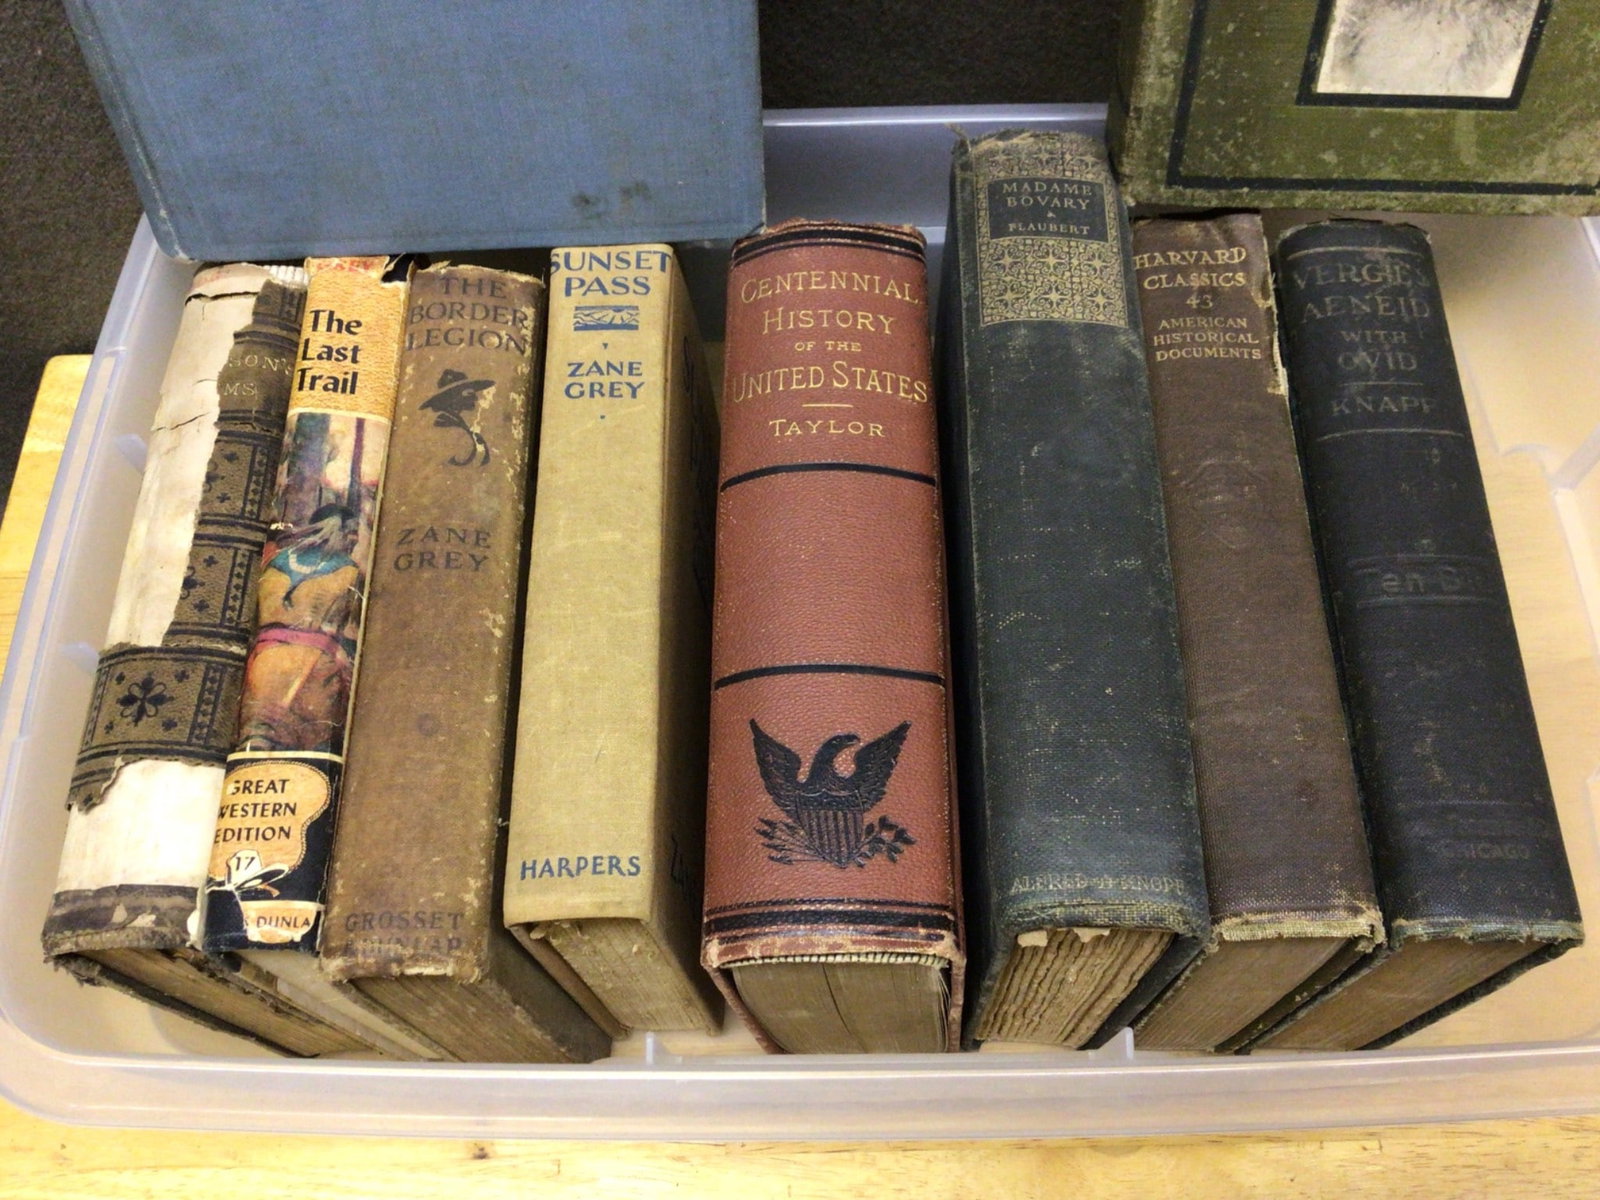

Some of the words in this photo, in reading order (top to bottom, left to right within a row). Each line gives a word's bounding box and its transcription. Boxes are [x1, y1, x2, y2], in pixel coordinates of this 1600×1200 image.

[1002, 181, 1092, 195] MADAME
[1006, 196, 1090, 210] BOVARY
[1008, 222, 1091, 235] FLAUBERT
[550, 250, 672, 276] SUNSET
[1133, 246, 1247, 270] HARVARD
[442, 276, 507, 299] THE
[564, 276, 651, 297] PASS
[741, 271, 919, 304] CENTENNIAL
[1143, 272, 1246, 290] CLASSICS
[1186, 294, 1213, 309] 43
[1302, 295, 1431, 323] AENEID
[310, 309, 363, 335] The
[410, 302, 529, 329] BORDER
[762, 307, 897, 335] HISTORY
[1158, 317, 1248, 330] AMERICAN
[407, 327, 527, 353] LEGION
[794, 341, 816, 351] OF
[824, 341, 862, 352] THE
[1153, 331, 1260, 346] HISTORICAL
[1340, 330, 1407, 344] WITH
[301, 338, 362, 364] Last
[1156, 348, 1262, 362] DOCUMENTS
[567, 360, 643, 377] ZANE
[297, 367, 359, 395] Trail
[564, 381, 645, 399] GREY
[733, 366, 825, 402] UNITED
[832, 360, 928, 403] STATES
[769, 418, 886, 437] TAYLOR
[397, 525, 492, 549] ZANE
[393, 551, 489, 572] GREY
[213, 826, 292, 844] EDITION
[235, 856, 256, 871] 17
[520, 855, 641, 880] HARPERS
[345, 910, 464, 932] GROSSET
